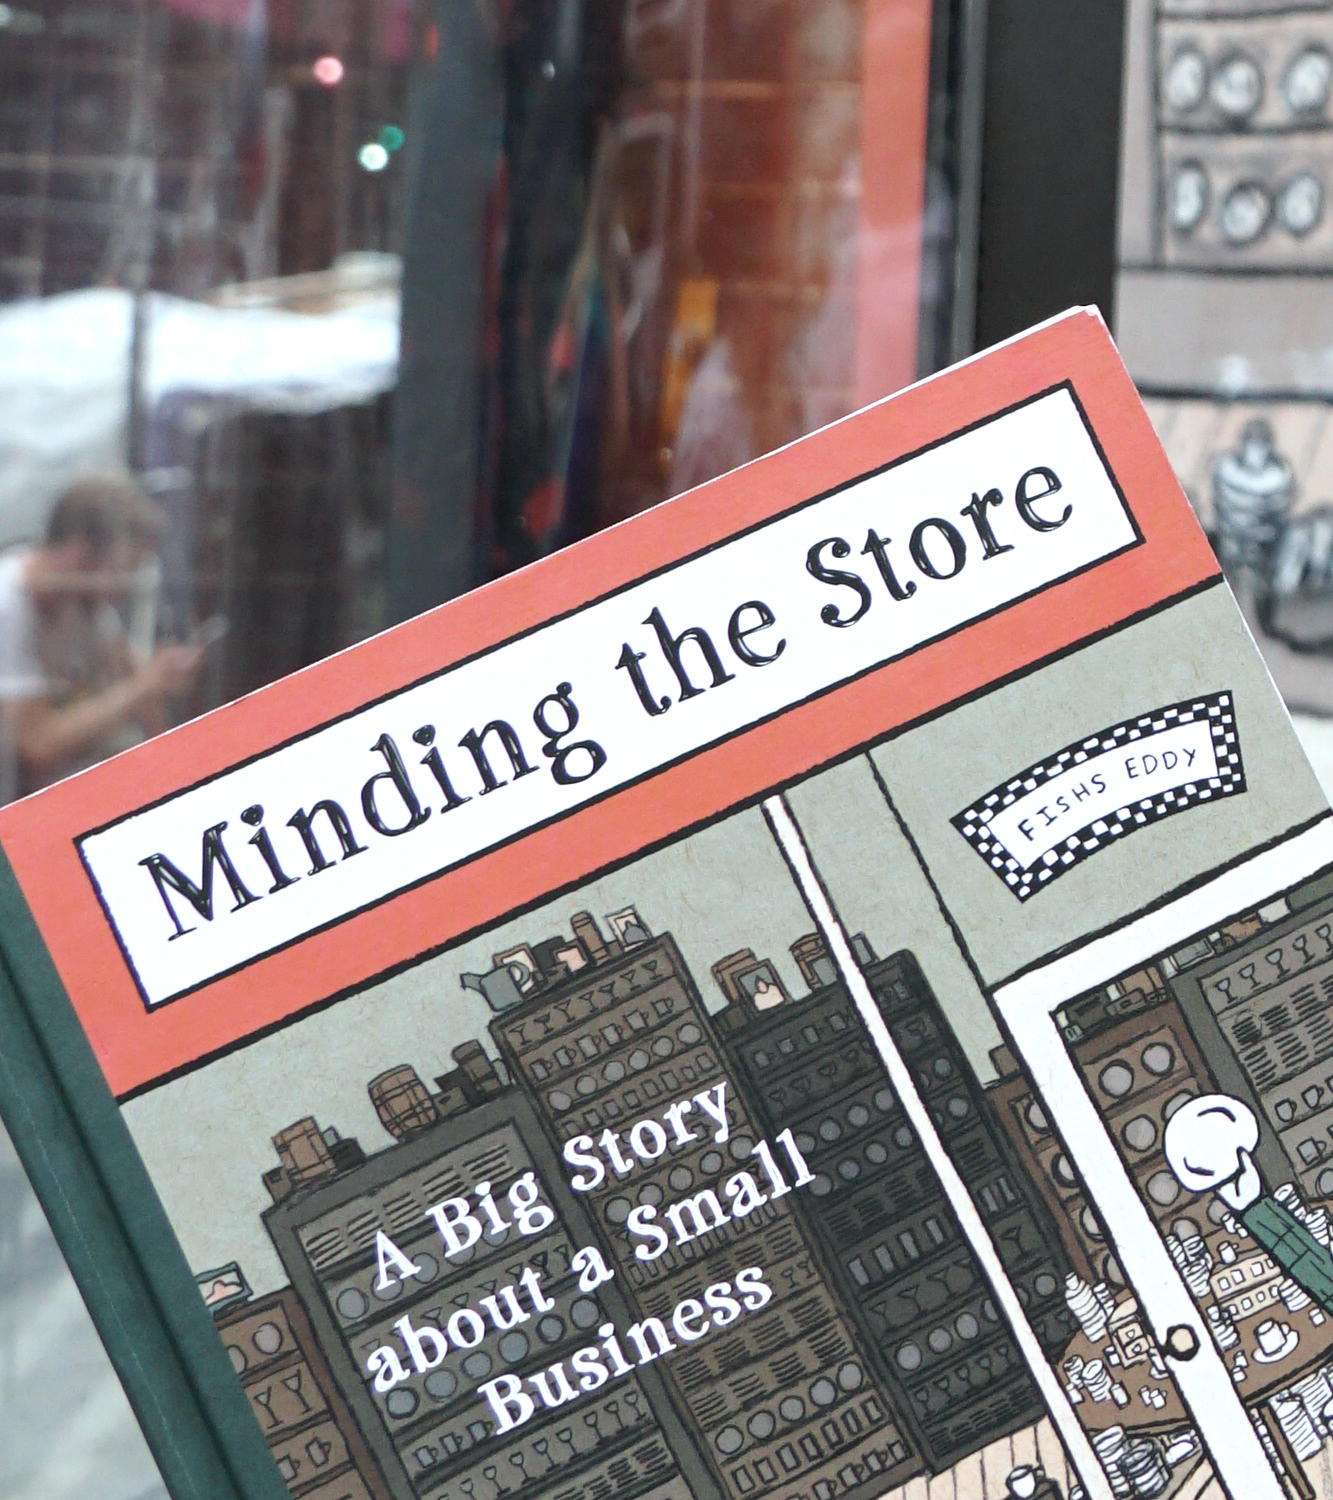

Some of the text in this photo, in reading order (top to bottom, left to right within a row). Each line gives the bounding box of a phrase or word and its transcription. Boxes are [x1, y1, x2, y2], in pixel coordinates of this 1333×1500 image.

[138, 465, 1073, 941] Minding the Store
[1017, 747, 1197, 842] FISHS EDDY
[367, 1128, 815, 1393] about a Small
[373, 1081, 729, 1291] A Big Story
[476, 1266, 772, 1436] Business
